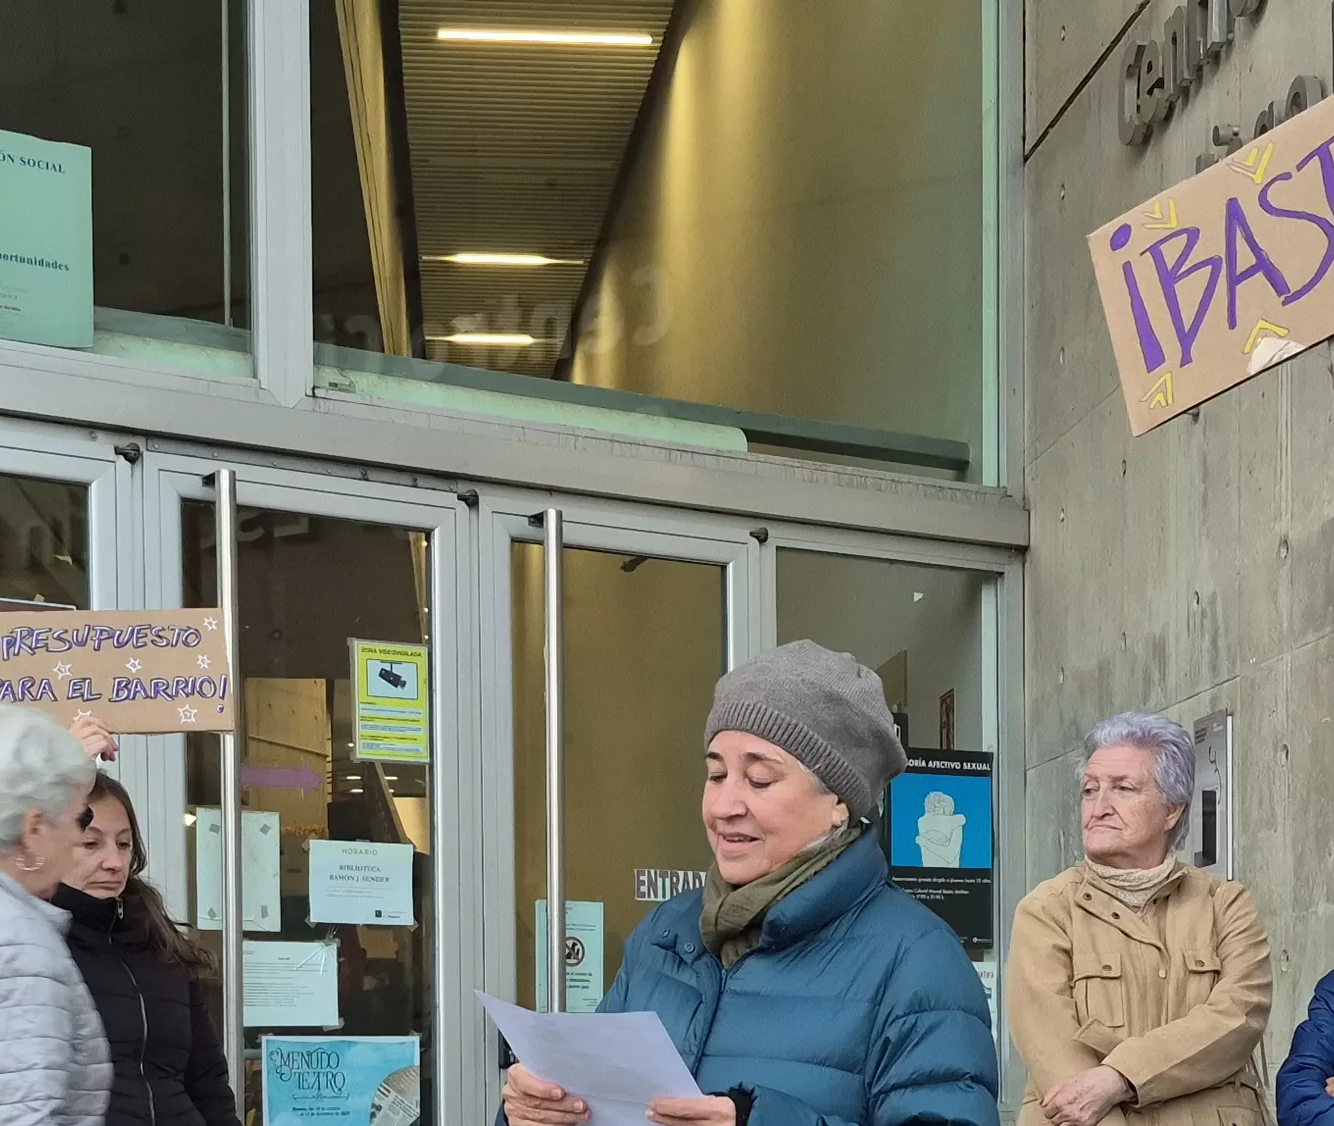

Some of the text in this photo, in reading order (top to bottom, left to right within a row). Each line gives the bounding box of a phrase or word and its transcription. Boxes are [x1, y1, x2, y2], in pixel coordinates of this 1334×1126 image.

[19, 156, 66, 175] SOCIAL
[67, 677, 102, 701] EL
[108, 674, 228, 714] BARRIO!
[928, 760, 961, 769] AFECTIVO
[962, 761, 991, 771] SEXUAL
[341, 848, 379, 856] HORARIO
[329, 873, 355, 882] RAMÓN
[361, 875, 390, 883] SENDER
[339, 864, 381, 873] BIBLIOTECA
[636, 870, 706, 899] ENTRAD
[269, 1047, 340, 1082] MENUDO
[293, 1071, 346, 1095] TEATRO
